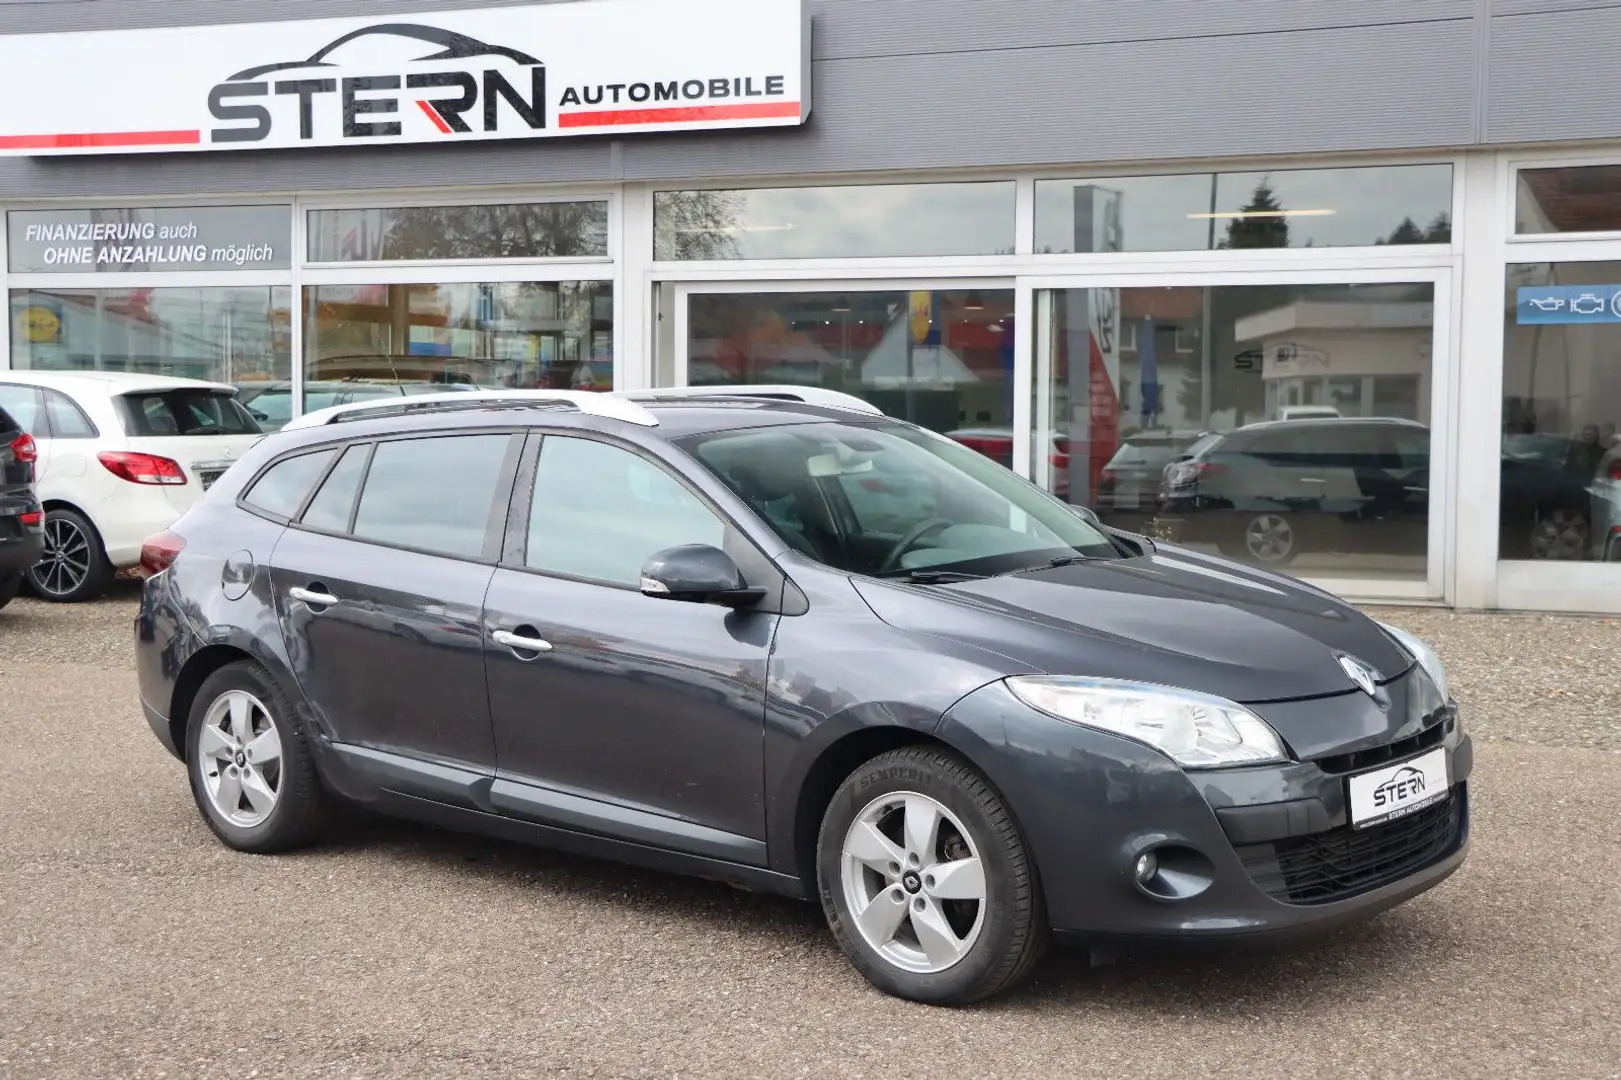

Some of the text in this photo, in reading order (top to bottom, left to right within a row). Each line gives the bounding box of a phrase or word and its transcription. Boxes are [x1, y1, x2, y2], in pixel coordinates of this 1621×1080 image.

[207, 67, 784, 143] STERN AUTOMOBILE
[25, 222, 197, 241] FINANZIERUNG auch
[43, 244, 272, 266] OHNE ANZAHLUNG möglich
[1373, 776, 1426, 807] STERN
